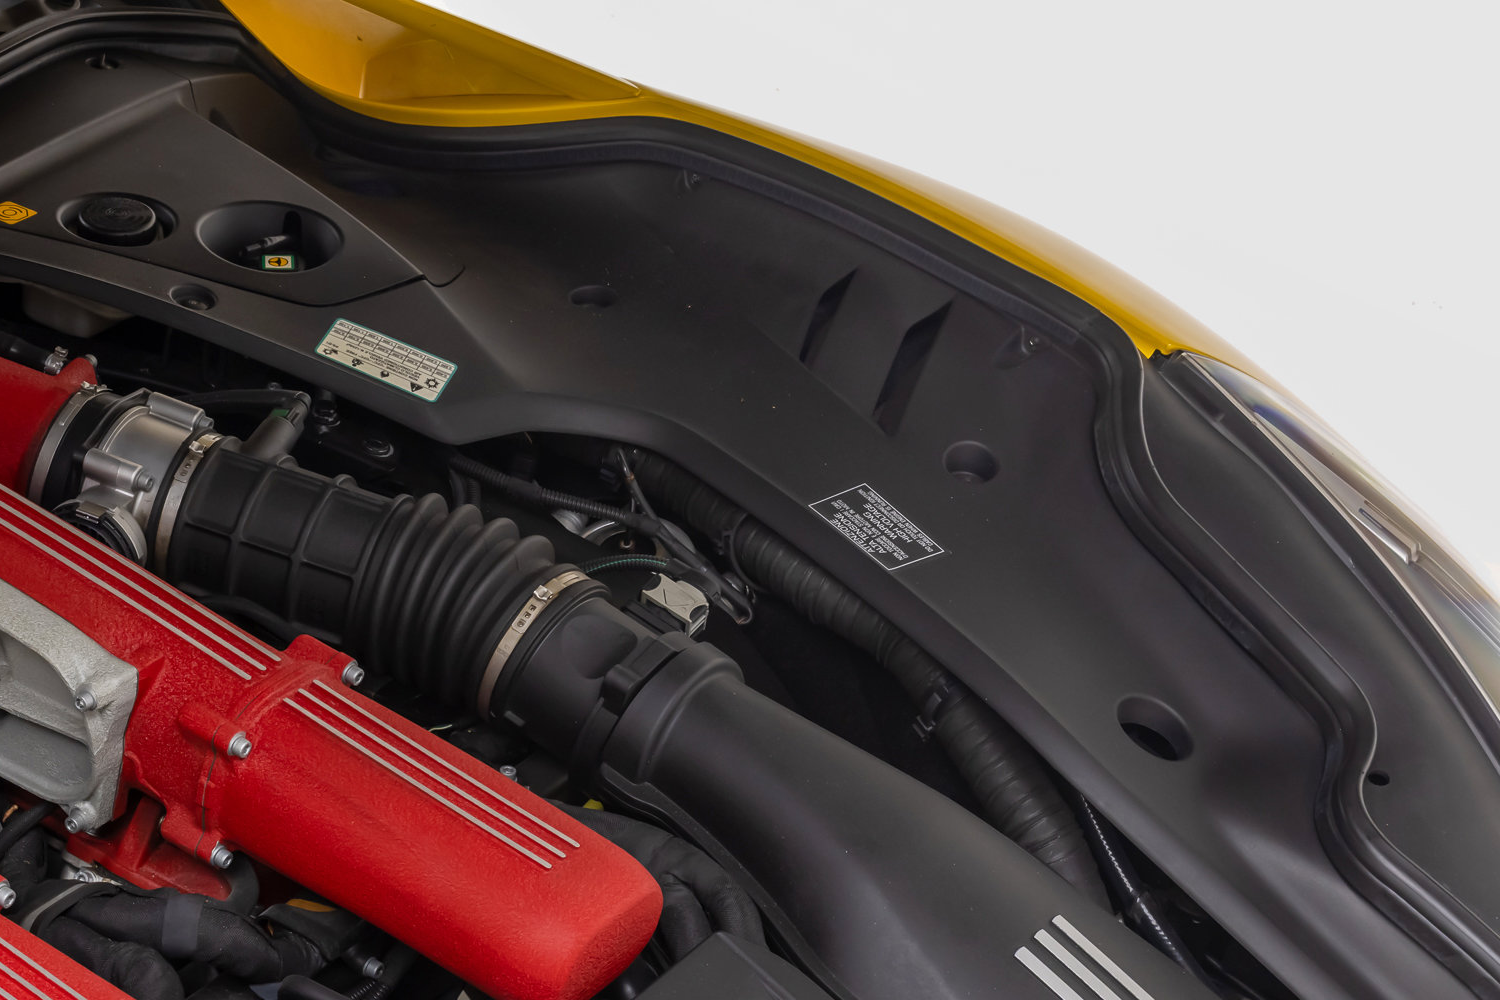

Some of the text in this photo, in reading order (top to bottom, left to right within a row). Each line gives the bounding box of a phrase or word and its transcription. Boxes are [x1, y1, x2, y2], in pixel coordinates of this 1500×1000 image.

[829, 517, 876, 553] ATTENZIONE
[831, 511, 888, 554] ALTA TENSIONE
[861, 502, 913, 543] HIGH VOLTAGE
[861, 511, 899, 539] WARNING
[914, 538, 927, 546] NOT
